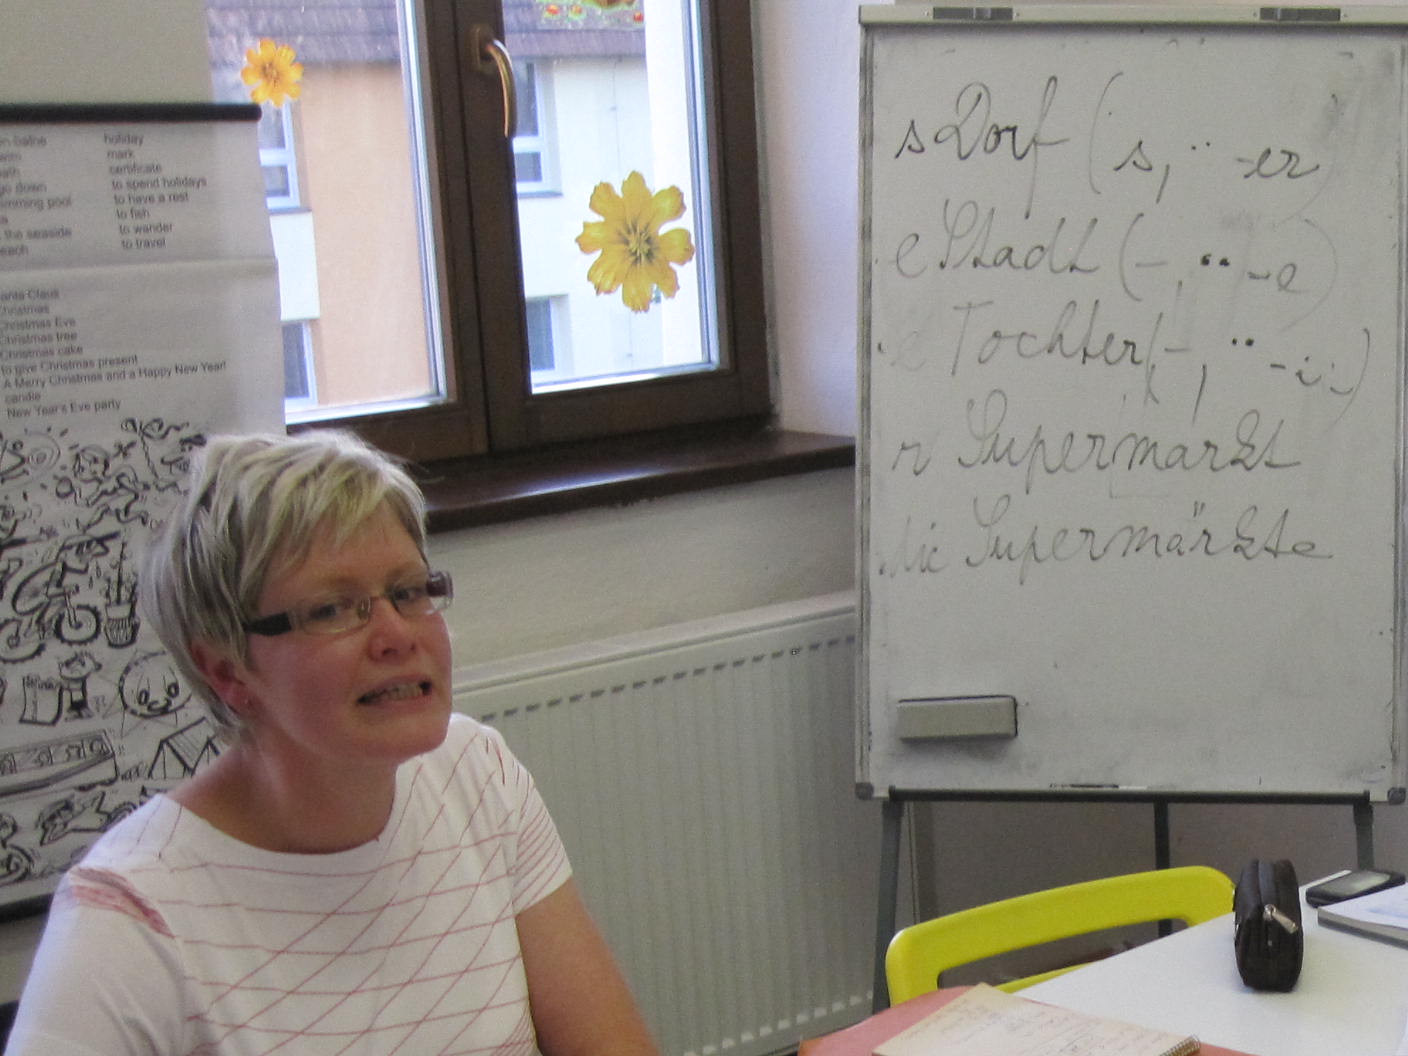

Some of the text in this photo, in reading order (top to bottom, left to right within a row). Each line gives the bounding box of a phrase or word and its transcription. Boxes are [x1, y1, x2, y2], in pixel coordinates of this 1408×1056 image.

[104, 132, 144, 146] holiday
[112, 180, 123, 190] to
[162, 176, 208, 189] holidays
[114, 193, 126, 204] to
[128, 193, 155, 204] have
[116, 207, 127, 219] to
[119, 223, 130, 235] to
[121, 238, 133, 249] to
[1, 365, 12, 376] to
[40, 358, 95, 371] Christmas
[14, 376, 46, 390] Merry
[49, 372, 103, 386] Christmas
[106, 368, 126, 381] and
[138, 366, 172, 379] Happy
[174, 363, 198, 375] New
[7, 407, 32, 420] New
[69, 401, 91, 413] Eve
[93, 398, 121, 413] party
[957, 388, 1302, 496] Supermarkt
